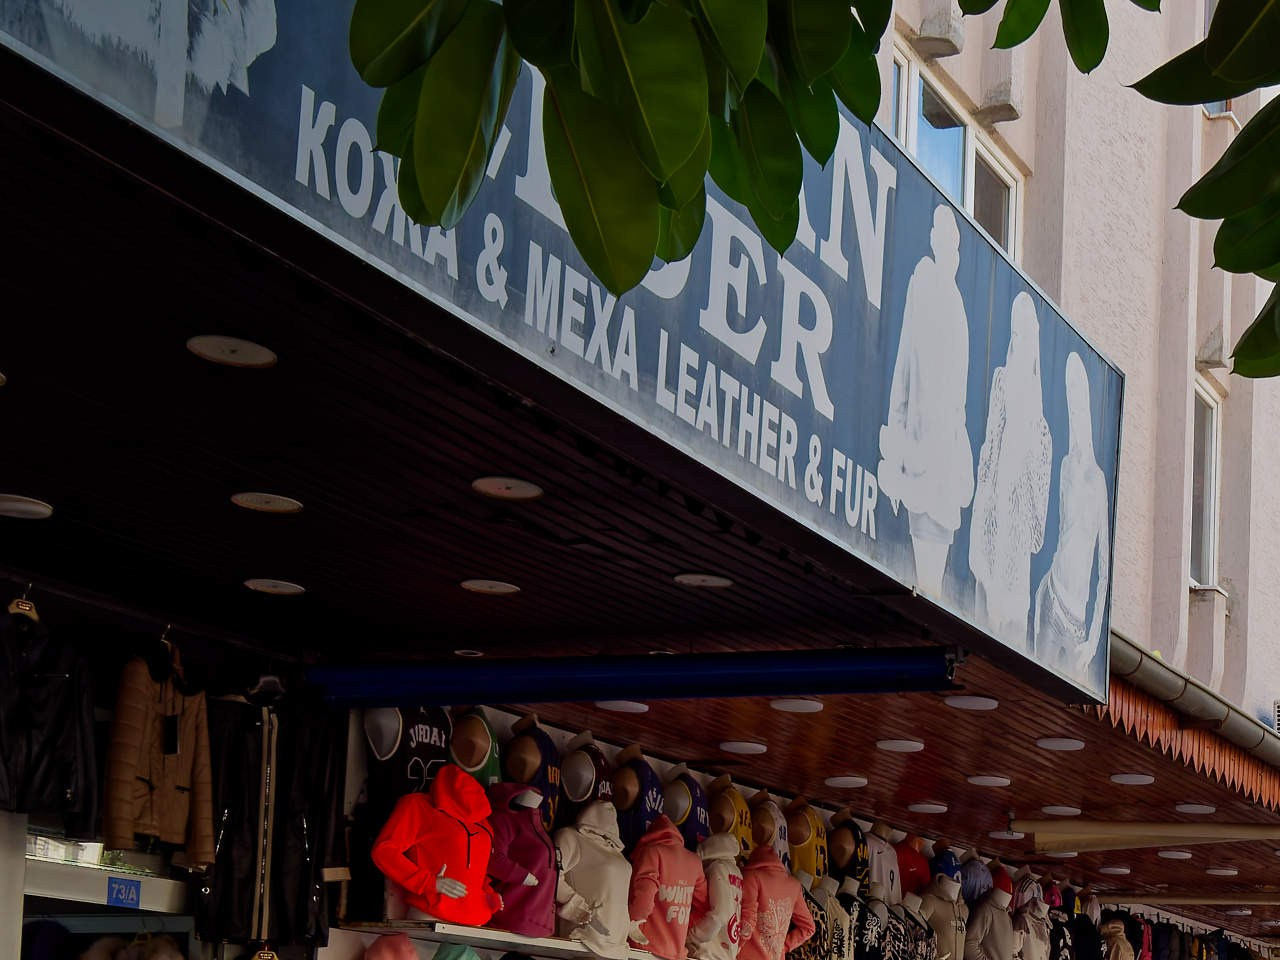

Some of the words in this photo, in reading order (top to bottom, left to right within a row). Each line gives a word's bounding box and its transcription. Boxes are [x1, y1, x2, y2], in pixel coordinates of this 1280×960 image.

[476, 213, 508, 310] &
[524, 240, 639, 393] МЕХА
[655, 328, 798, 490] LEATHER
[804, 434, 824, 507] &
[829, 447, 878, 540] FUR
[111, 883, 137, 904] 73/A
